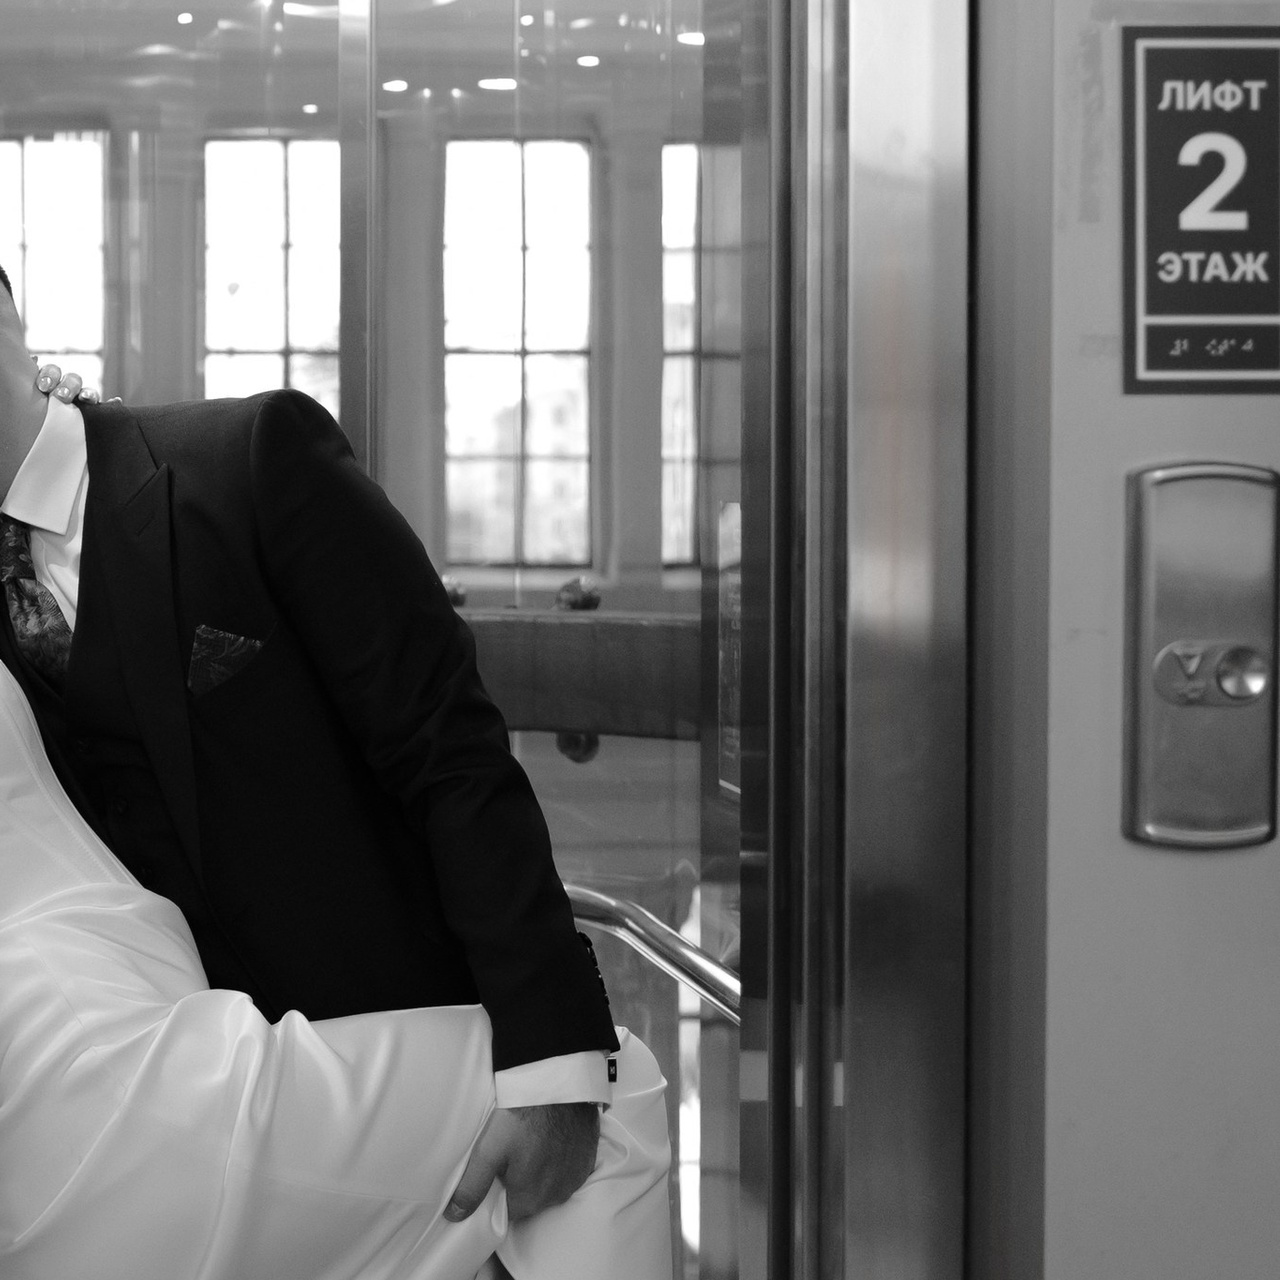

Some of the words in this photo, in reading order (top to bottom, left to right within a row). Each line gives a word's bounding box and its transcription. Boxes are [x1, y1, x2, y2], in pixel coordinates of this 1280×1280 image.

[1157, 79, 1268, 112] ЛИФТ
[1177, 131, 1249, 231] 2
[1156, 251, 1269, 283] ЭТАЖ
